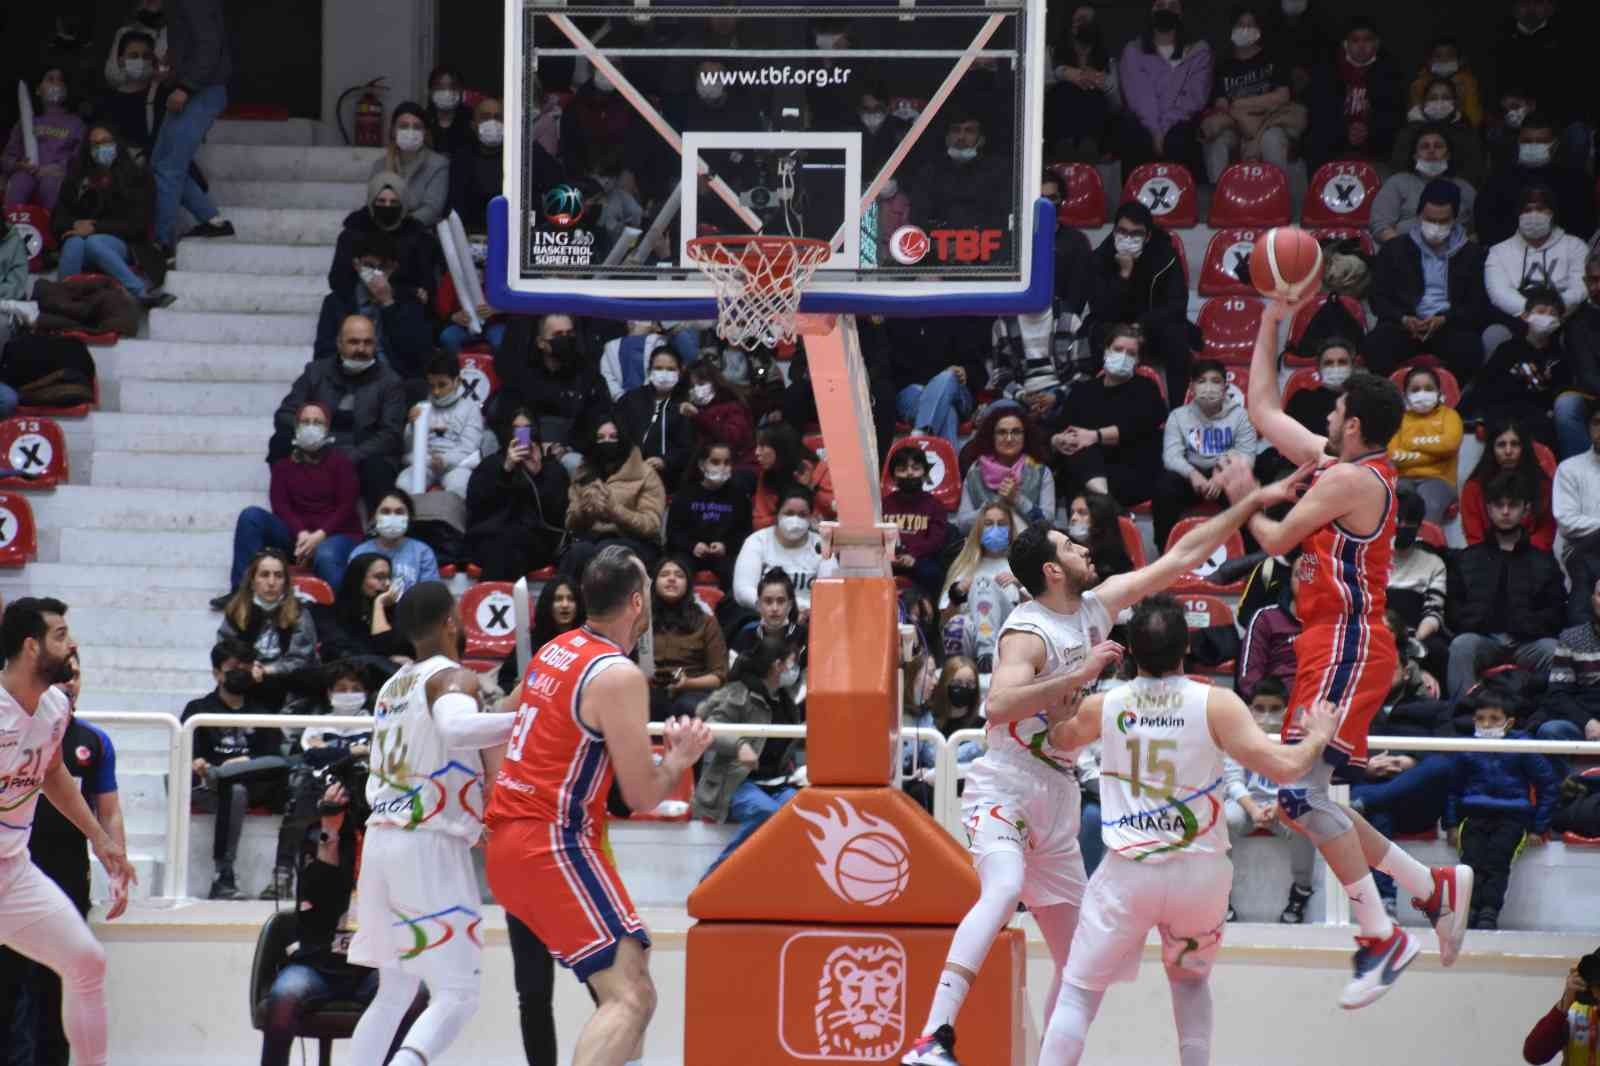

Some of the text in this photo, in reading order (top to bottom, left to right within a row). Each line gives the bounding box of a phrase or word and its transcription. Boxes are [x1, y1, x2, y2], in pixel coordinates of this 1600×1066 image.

[700, 66, 851, 87] www.tbf.org.tr
[1243, 166, 1262, 176] 10
[8, 212, 31, 222] 12
[534, 231, 569, 246] ING
[1233, 231, 1254, 241] 10
[533, 246, 592, 256] BASKETBOL
[930, 229, 1003, 261] TBF
[1223, 300, 1246, 312] 10
[17, 421, 41, 431] 13
[1203, 426, 1233, 453] NBA
[18, 443, 44, 469] X
[1184, 600, 1208, 612] 10
[486, 604, 511, 629] X
[1140, 715, 1184, 728] Petkim
[17, 748, 42, 777] 21
[1126, 738, 1177, 799] 15
